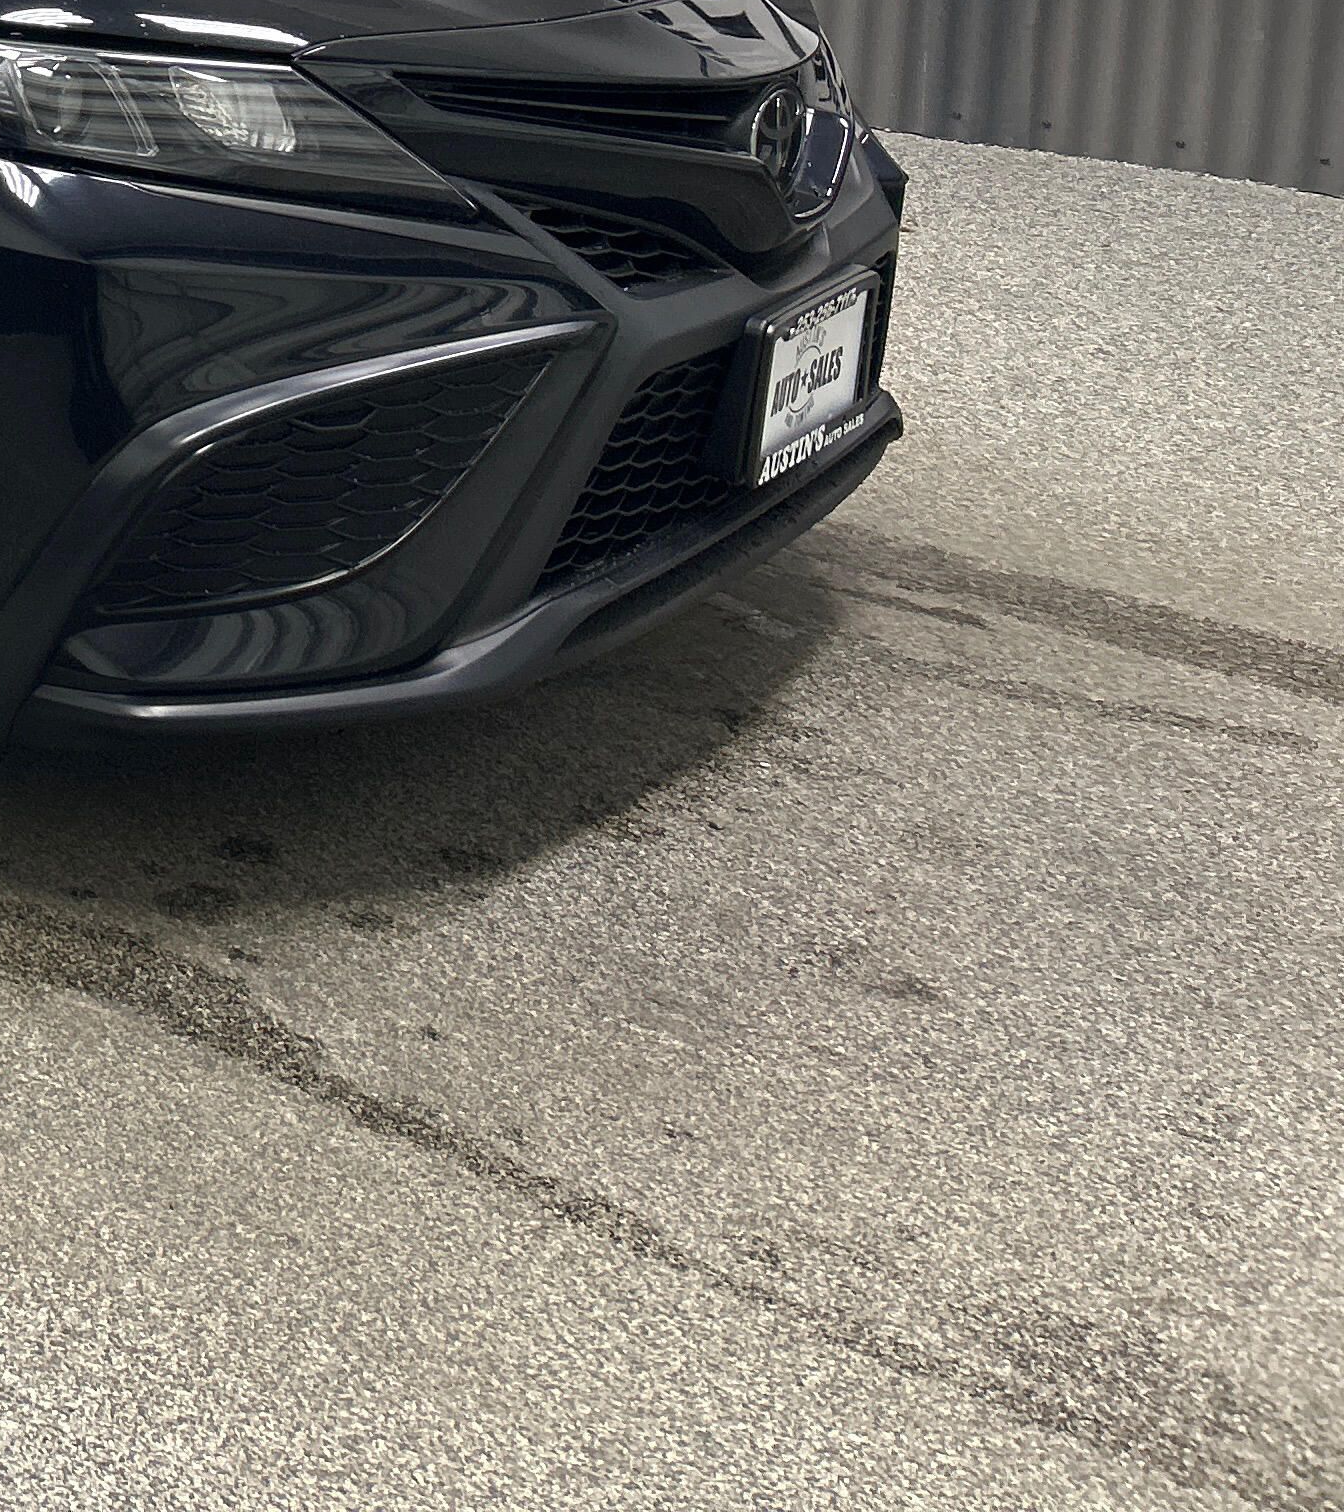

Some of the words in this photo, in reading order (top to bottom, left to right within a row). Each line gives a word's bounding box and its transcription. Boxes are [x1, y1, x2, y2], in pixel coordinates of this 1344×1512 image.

[770, 368, 802, 418] AUTO
[807, 346, 843, 394] SALES
[758, 423, 826, 486] AUSTIN'S
